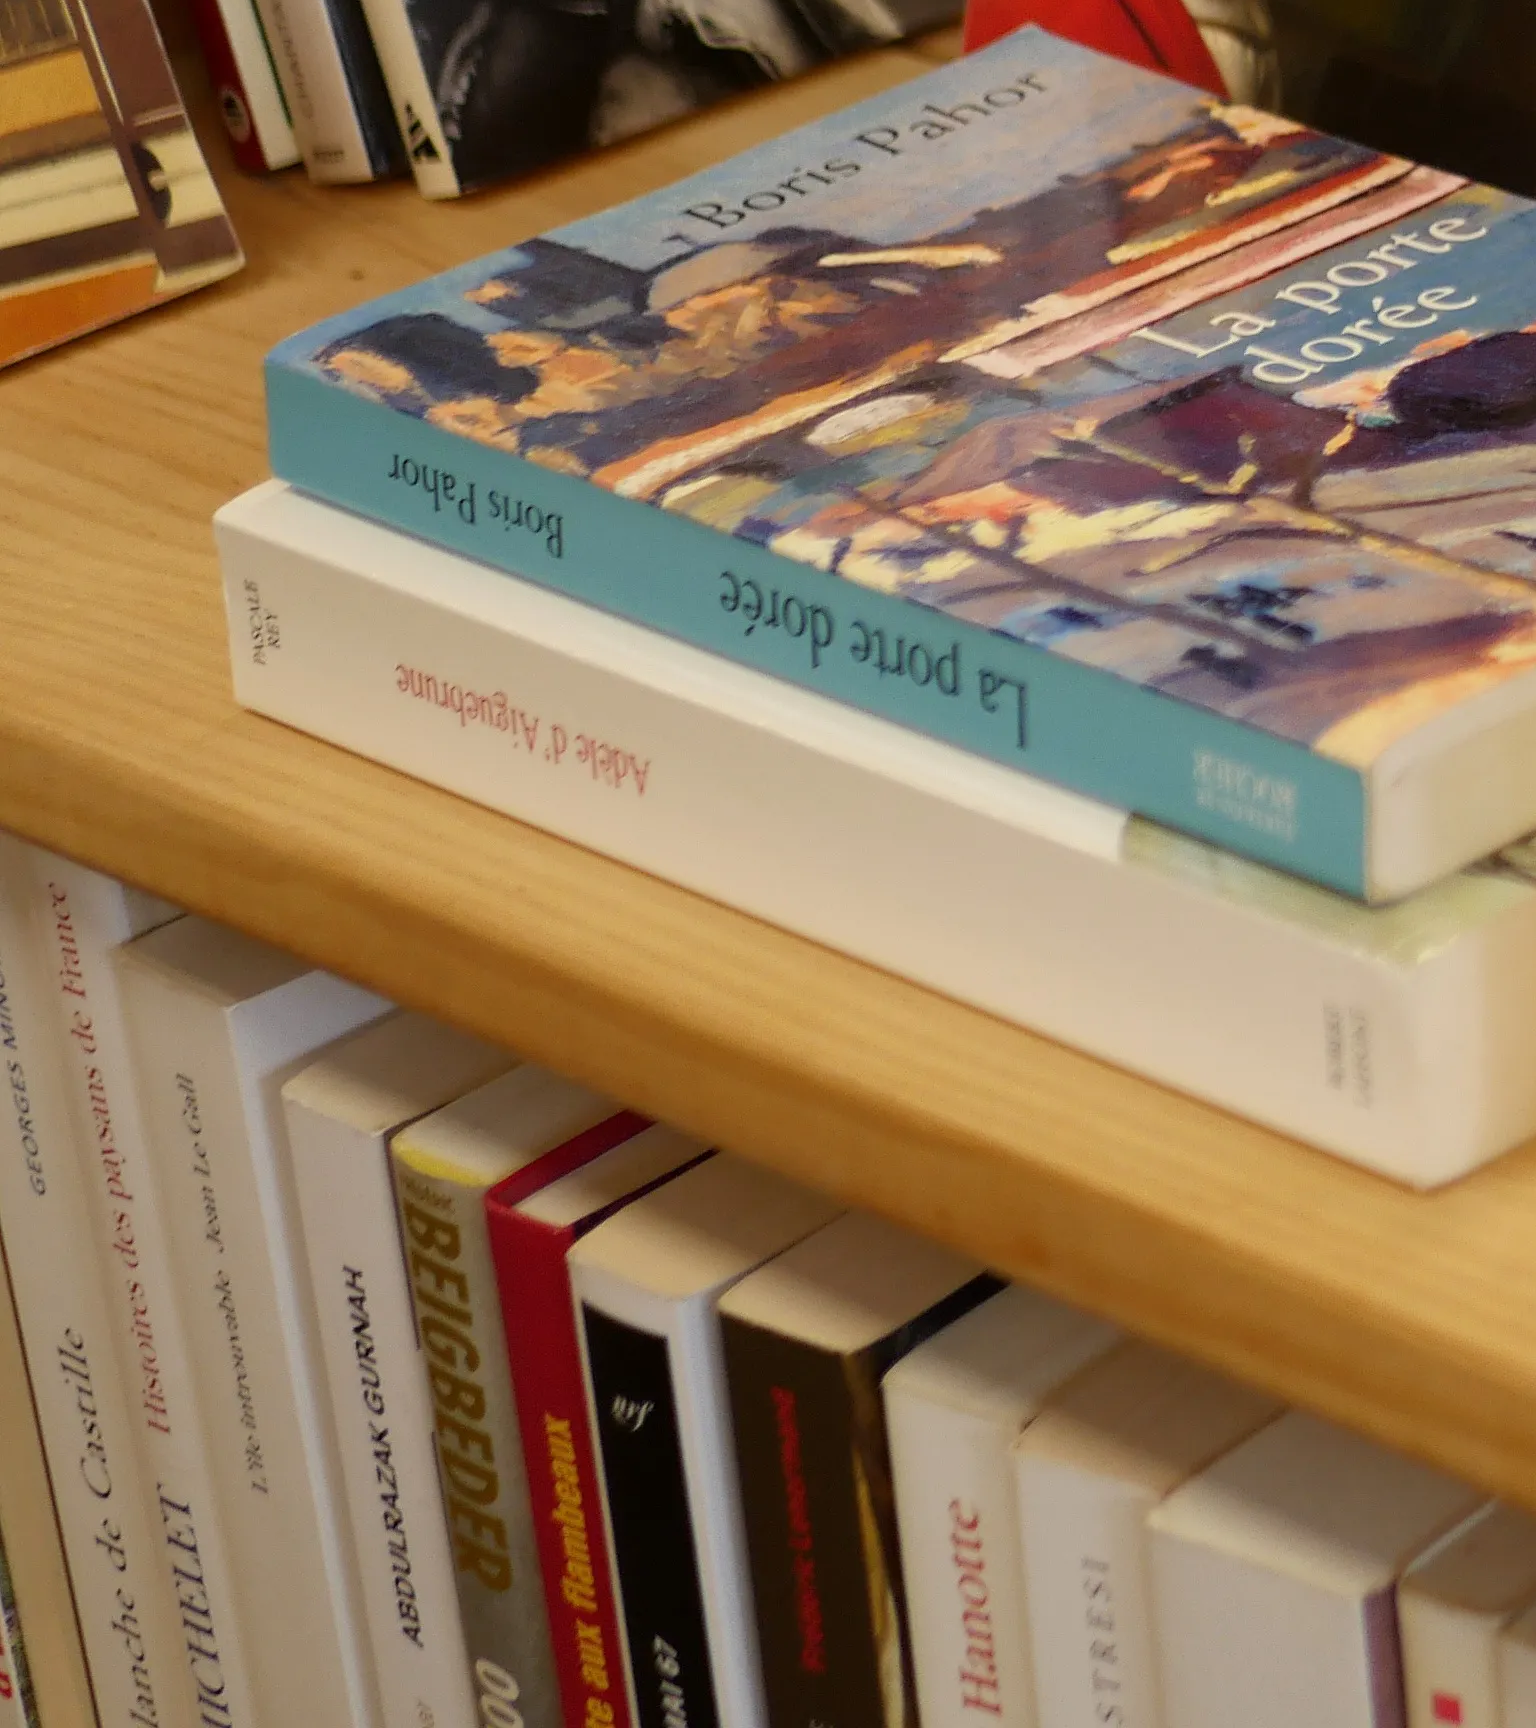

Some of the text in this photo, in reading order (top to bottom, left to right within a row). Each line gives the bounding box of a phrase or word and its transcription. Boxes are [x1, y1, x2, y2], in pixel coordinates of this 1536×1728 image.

[681, 64, 1053, 235] Boris Pahor
[1134, 207, 1494, 365] La porte
[1250, 278, 1481, 394] dorée
[387, 449, 566, 561] Boris Pahor
[241, 576, 269, 668] PASCALE
[260, 608, 282, 651] REY
[717, 569, 1033, 752] La porte dorée
[6, 1059, 47, 1197] GEORGES
[48, 882, 174, 1437] Histoires des paysans de France
[174, 1071, 226, 1255] Jean Le Gall
[56, 1326, 113, 1500] Castille
[213, 1269, 259, 1431] introuvable
[342, 1264, 386, 1418] GURNAH
[401, 1200, 515, 1594] BEIGBEDER
[95, 1517, 128, 1573] de
[360, 1420, 426, 1650] ABDULRAZAK
[543, 1410, 599, 1613] flambeaux
[575, 1618, 611, 1692] aux
[946, 1497, 1004, 1720] Hanotte
